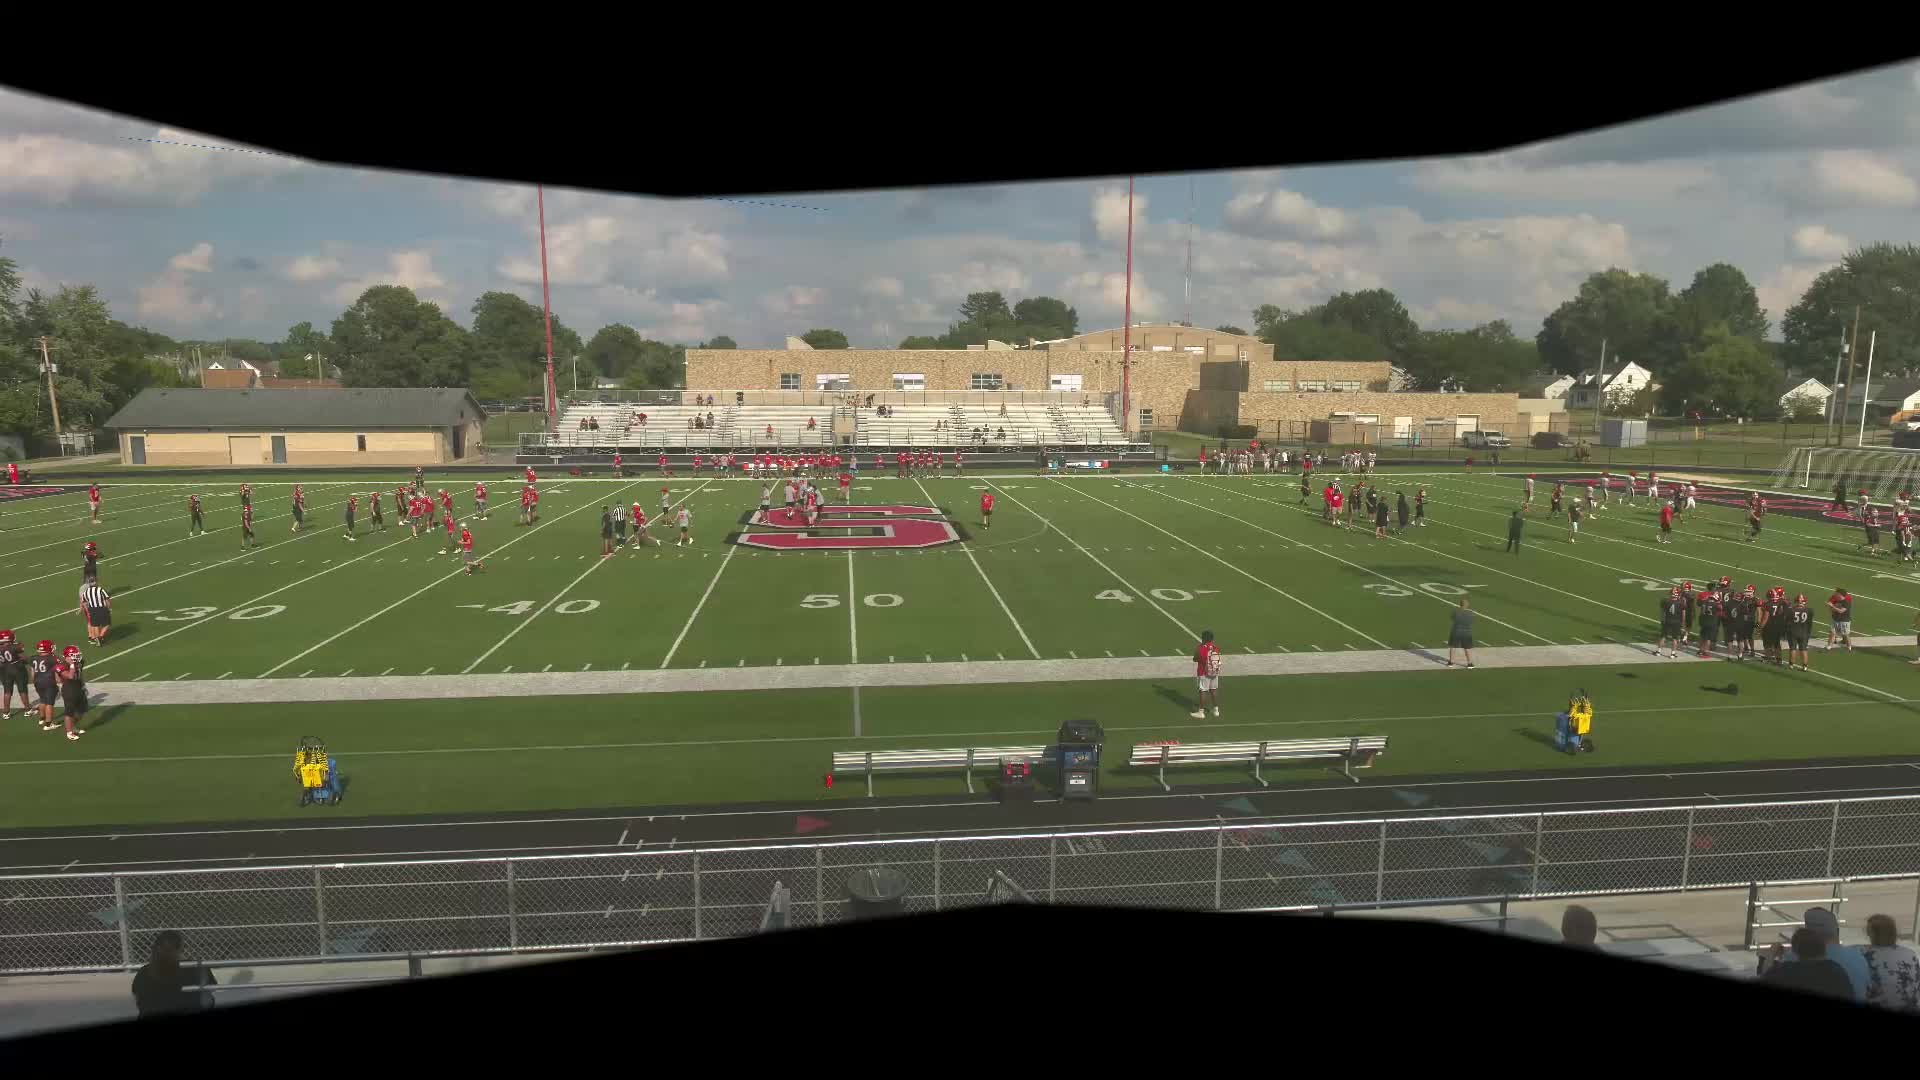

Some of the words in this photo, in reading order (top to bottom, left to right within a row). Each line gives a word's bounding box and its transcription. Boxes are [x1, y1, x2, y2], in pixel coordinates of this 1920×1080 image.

[737, 505, 960, 549] S
[1095, 588, 1194, 602] 40
[1362, 582, 1468, 597] 30
[487, 599, 601, 615] 40
[800, 594, 904, 608] 50
[155, 605, 287, 621] 30
[1794, 611, 1808, 623] 59
[33, 660, 46, 673] 26
